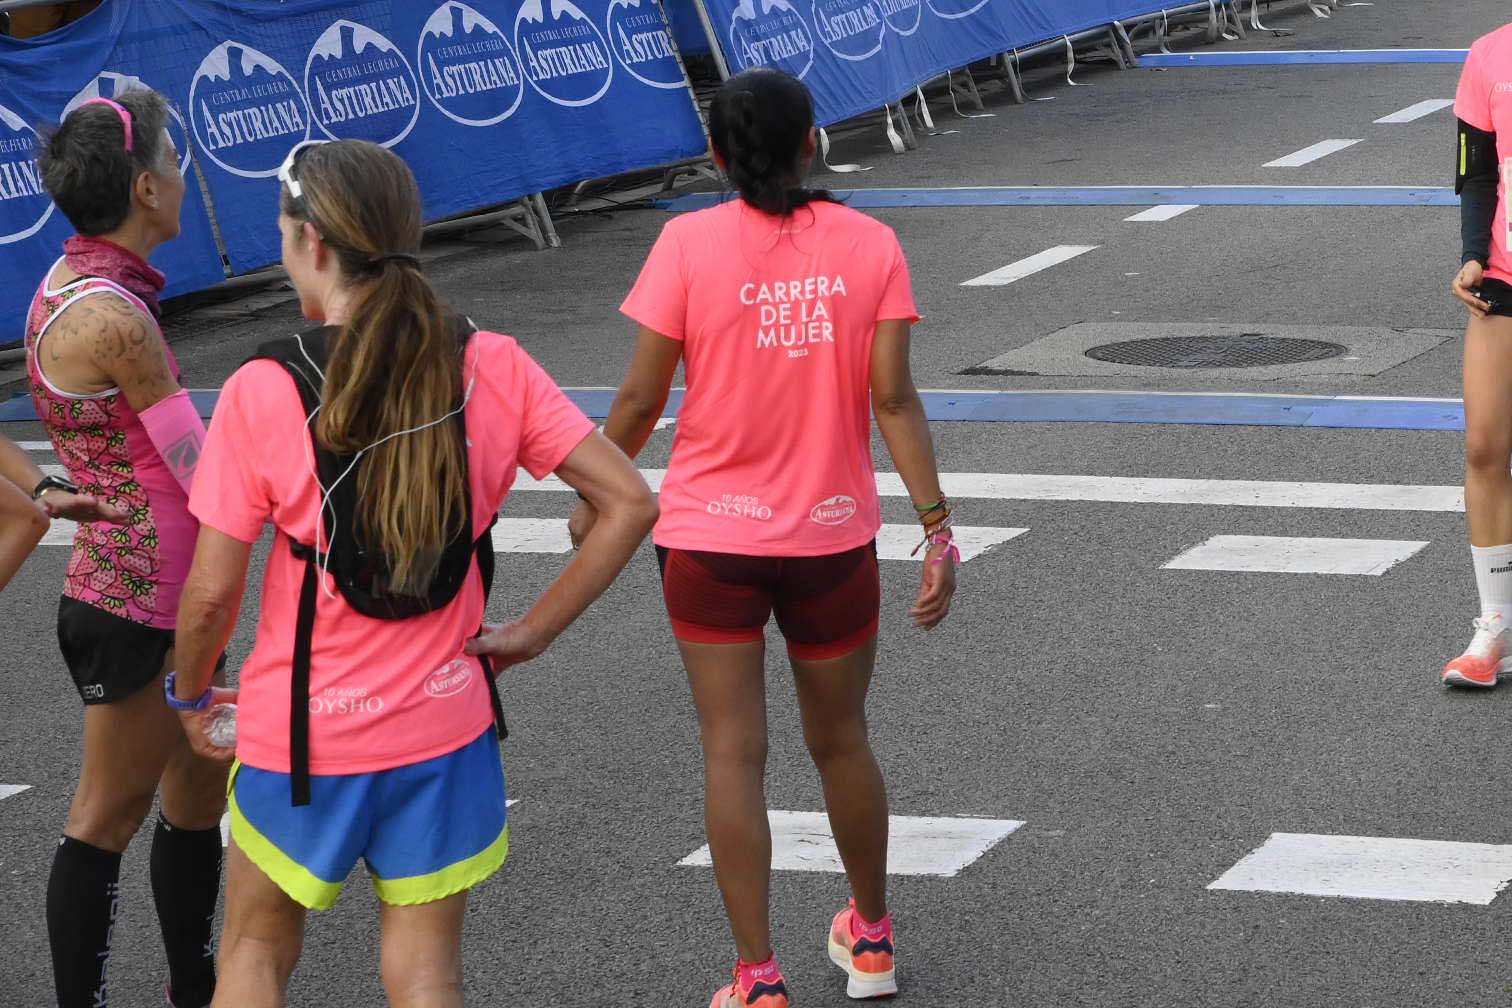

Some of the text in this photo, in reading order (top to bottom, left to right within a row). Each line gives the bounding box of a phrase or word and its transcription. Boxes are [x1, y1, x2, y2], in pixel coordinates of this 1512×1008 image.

[522, 35, 609, 81] ASTURIANA
[325, 66, 360, 83] CENTRAL
[428, 52, 520, 100] ASTURIANA
[212, 80, 290, 106] CENTRAL LECHERA
[314, 74, 416, 126] ASTURIANA
[200, 96, 305, 150] ASTURIANA
[740, 275, 847, 306] CARRERA
[760, 299, 829, 327] DE LA
[757, 321, 834, 349] MUJER
[706, 500, 773, 520] OYSHO
[308, 695, 384, 714] OYSHO
